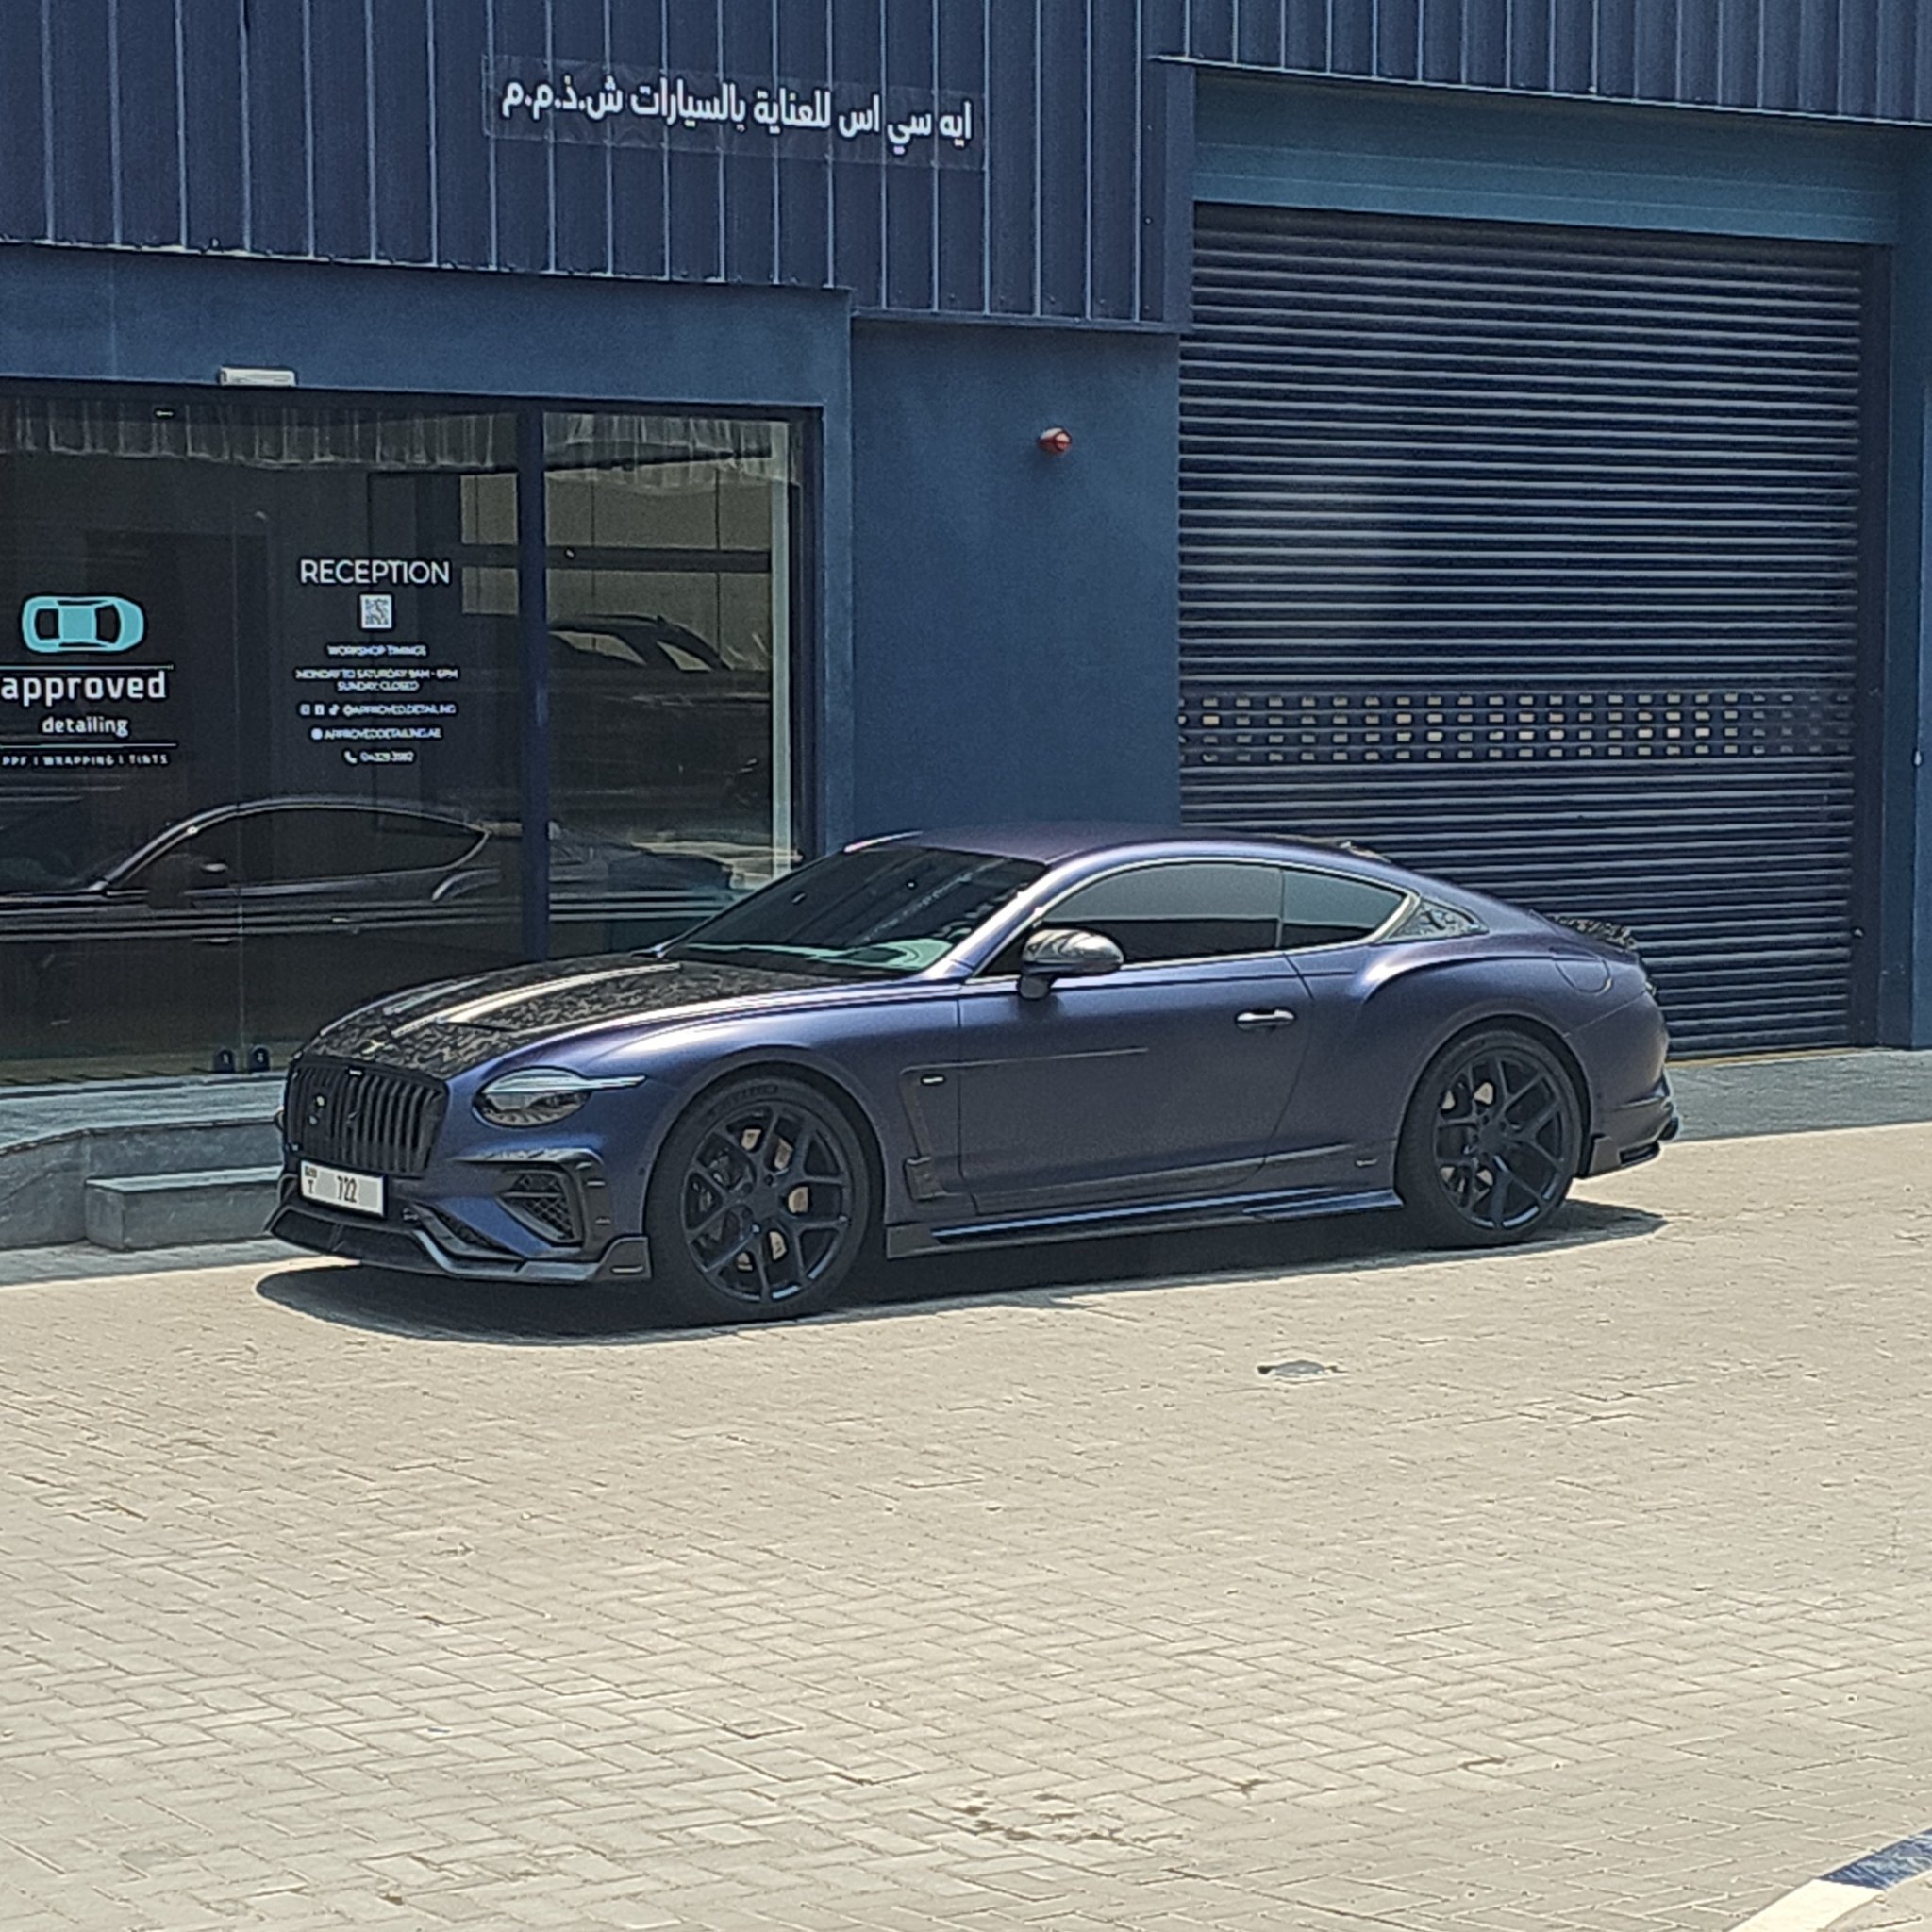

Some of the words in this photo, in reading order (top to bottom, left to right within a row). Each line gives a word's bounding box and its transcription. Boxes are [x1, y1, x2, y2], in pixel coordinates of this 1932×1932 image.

[629, 76, 747, 133] بالسيارات
[753, 87, 832, 135] للعناية
[838, 94, 881, 139] اس
[887, 113, 933, 156] سي
[300, 558, 451, 585] RECEPTION
[1, 670, 167, 707] approved
[42, 716, 129, 738] detailing
